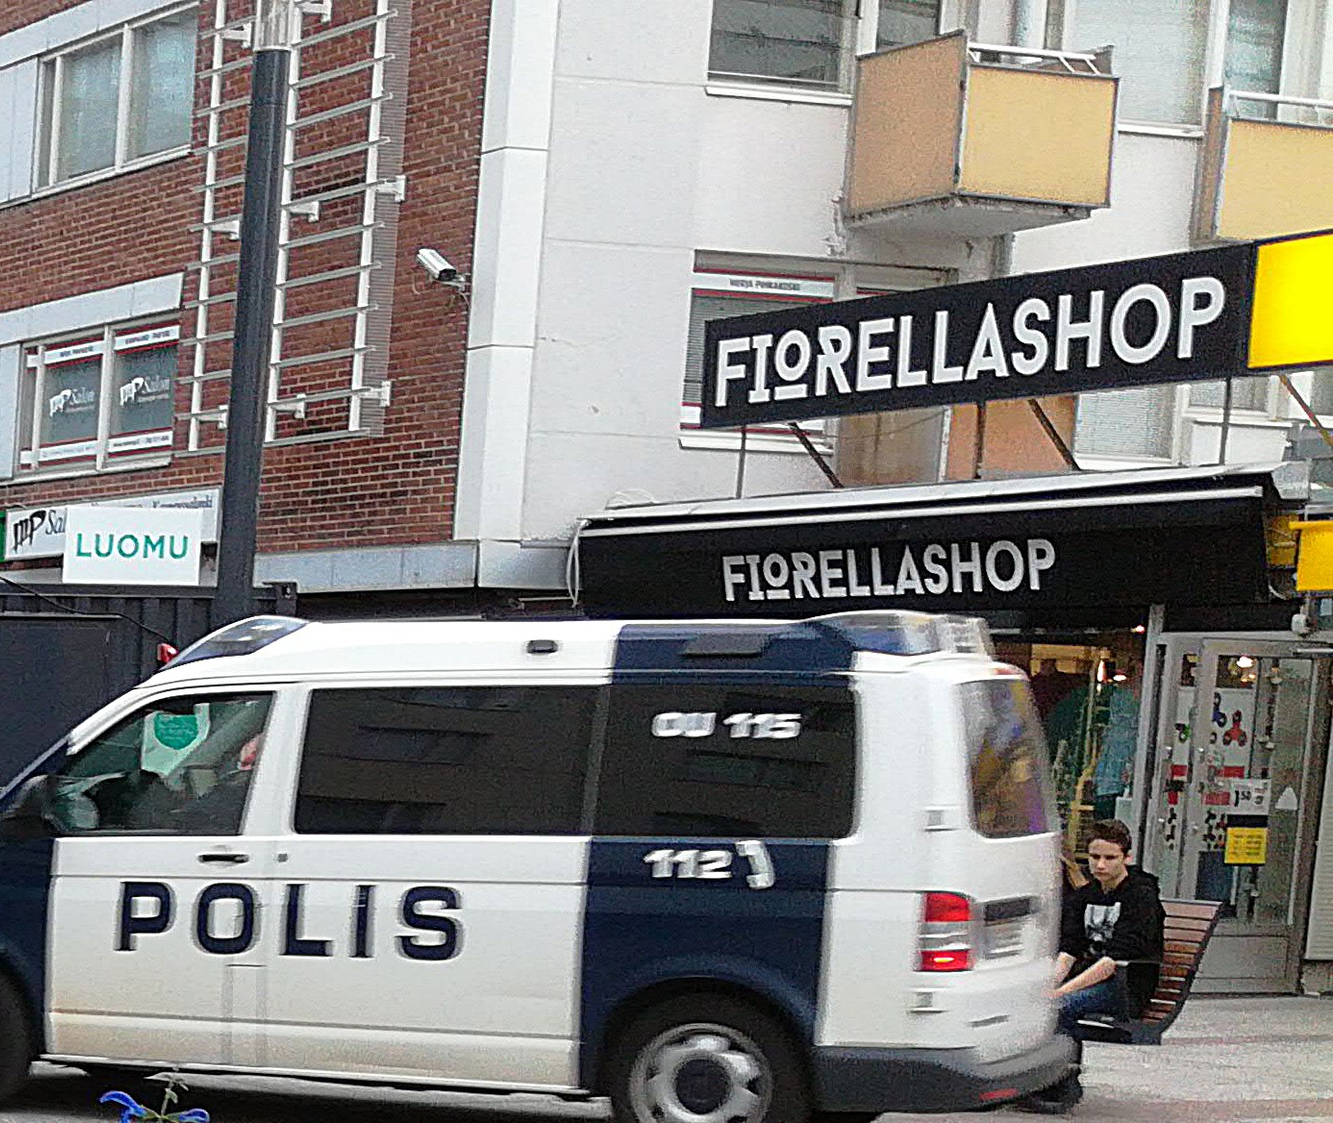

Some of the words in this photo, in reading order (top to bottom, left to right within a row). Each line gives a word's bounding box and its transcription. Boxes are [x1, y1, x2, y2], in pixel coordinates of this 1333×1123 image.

[715, 277, 1225, 407] FIORELLASHOP
[76, 533, 188, 559] LUOMU
[722, 539, 1055, 601] FIORELLASHOP
[722, 712, 802, 739] 115
[642, 848, 733, 880] 112
[113, 879, 469, 964] POLIS
